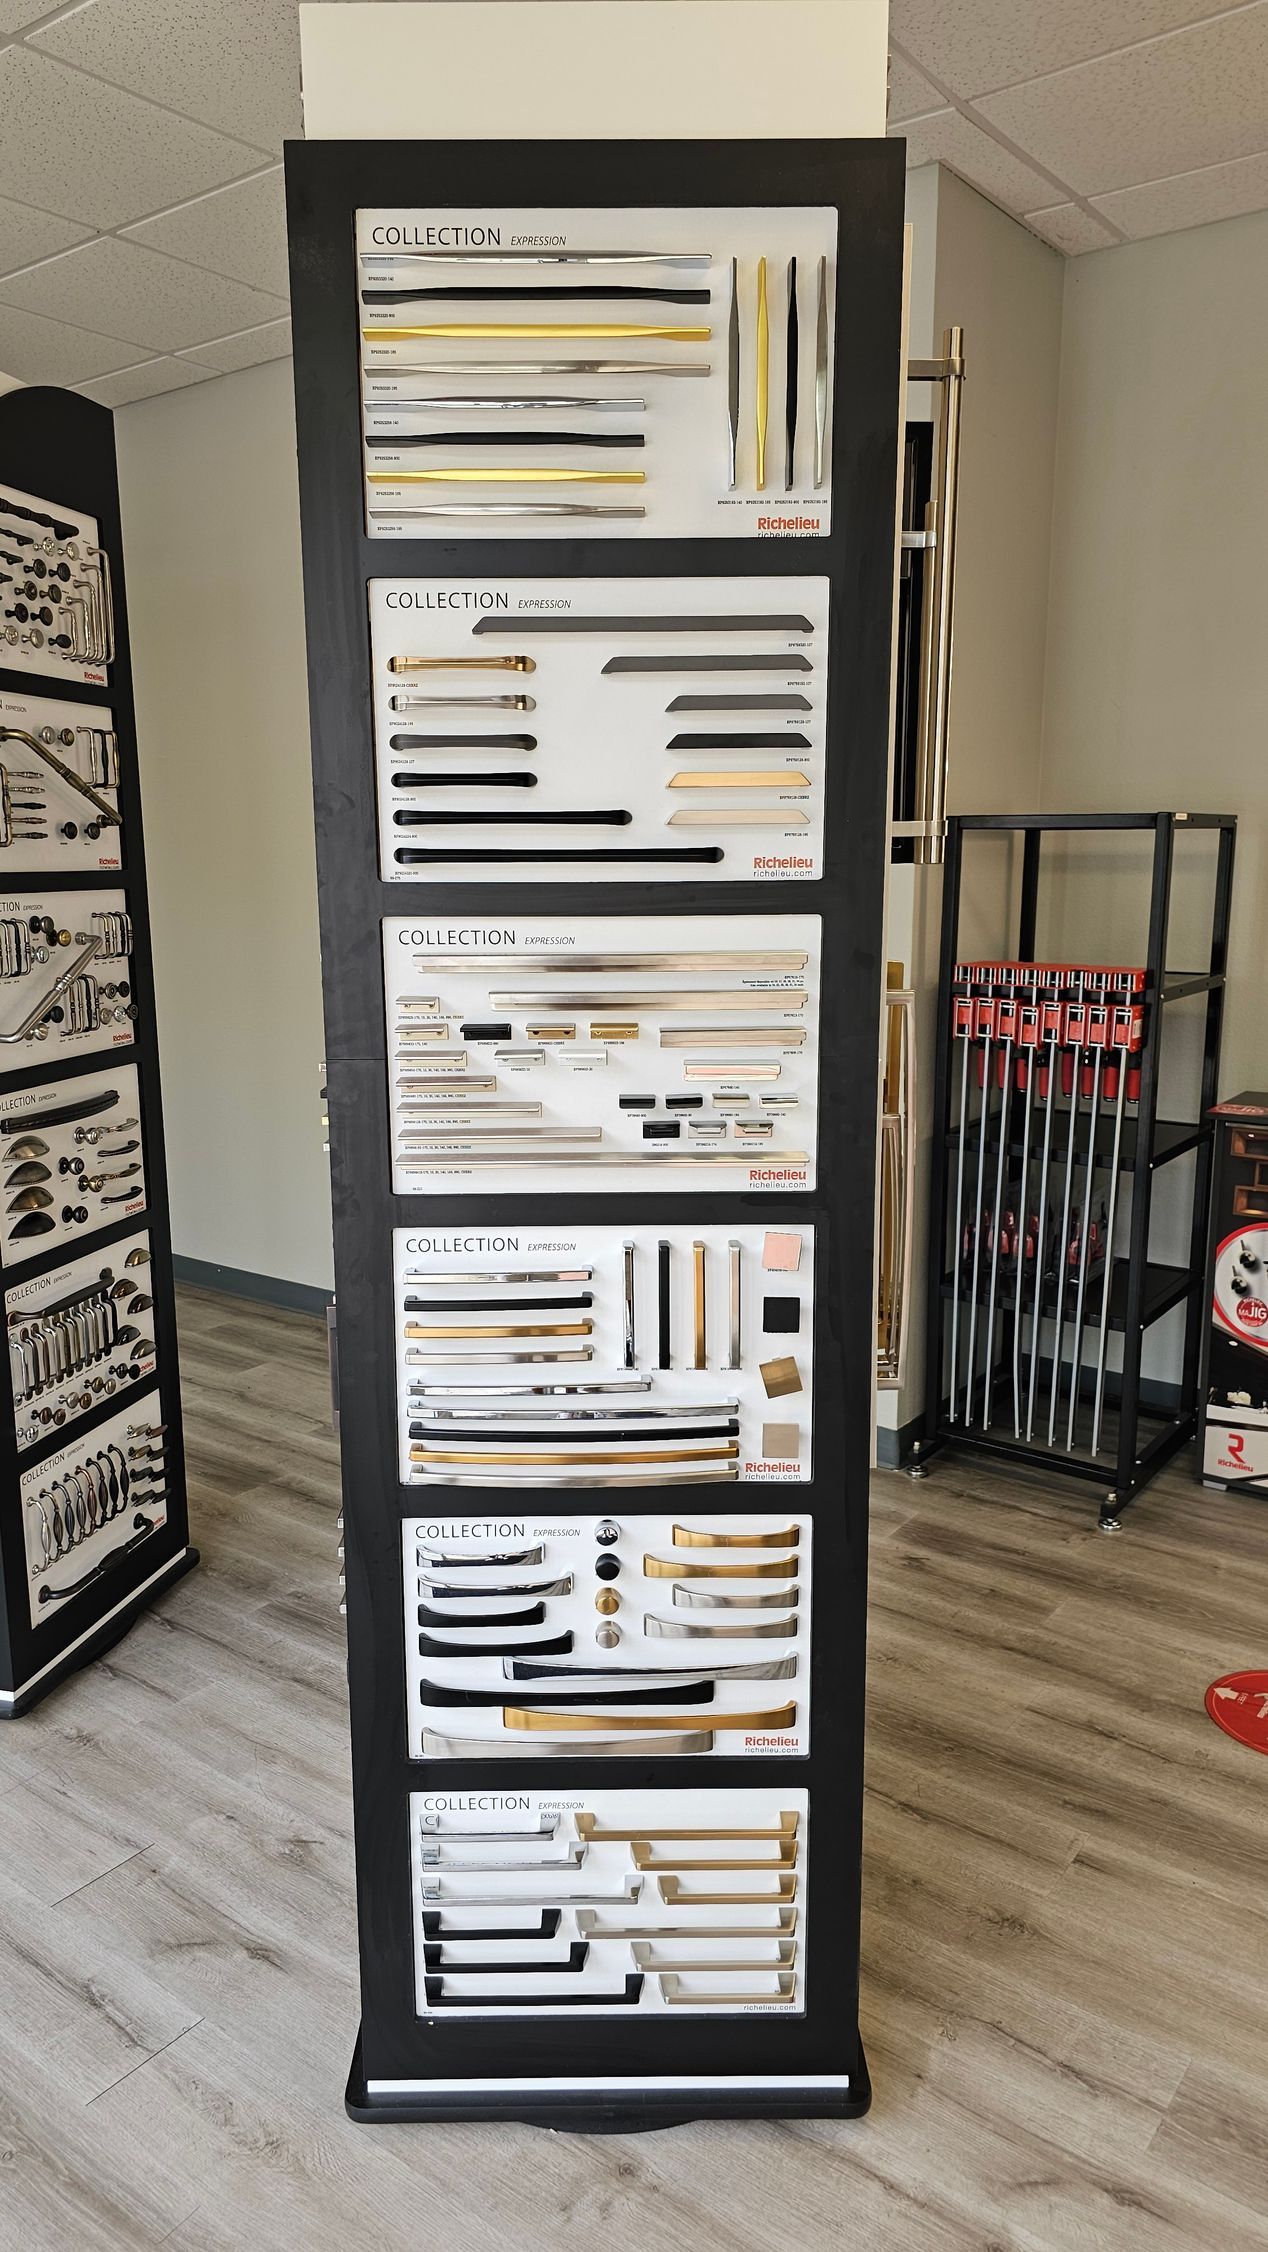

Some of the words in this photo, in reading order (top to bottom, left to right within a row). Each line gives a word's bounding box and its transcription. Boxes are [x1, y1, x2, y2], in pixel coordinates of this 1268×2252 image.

[373, 227, 500, 245] COLLECTION
[511, 235, 566, 246] EXPRESSION
[758, 516, 819, 529] Richelieu
[386, 592, 508, 609] COLLECTION
[518, 600, 571, 609] EXPRESSION
[754, 857, 813, 868] Richelieu
[753, 869, 813, 877] richelieu.com
[399, 930, 516, 946] COLLECTION
[525, 936, 575, 945] EXPRESSION
[750, 1170, 807, 1181] Richelieu
[749, 1181, 807, 1189] richelieu.com
[406, 1238, 518, 1253] COLLECTION
[527, 1242, 576, 1252] EXPRESSION
[6, 1277, 51, 1304] COLLECTION
[22, 1453, 65, 1486] COLLECTION
[745, 1463, 800, 1473] Richelieu
[1217, 1458, 1254, 1473] Richelieu
[416, 1524, 524, 1539] COLLECTION
[533, 1529, 580, 1537] EXPRESSION
[745, 1737, 798, 1747] Richelieu
[424, 1797, 530, 1811] COLLECTION
[538, 1802, 584, 1810] EXPRESSION
[743, 2004, 796, 2012] richelieu.com
